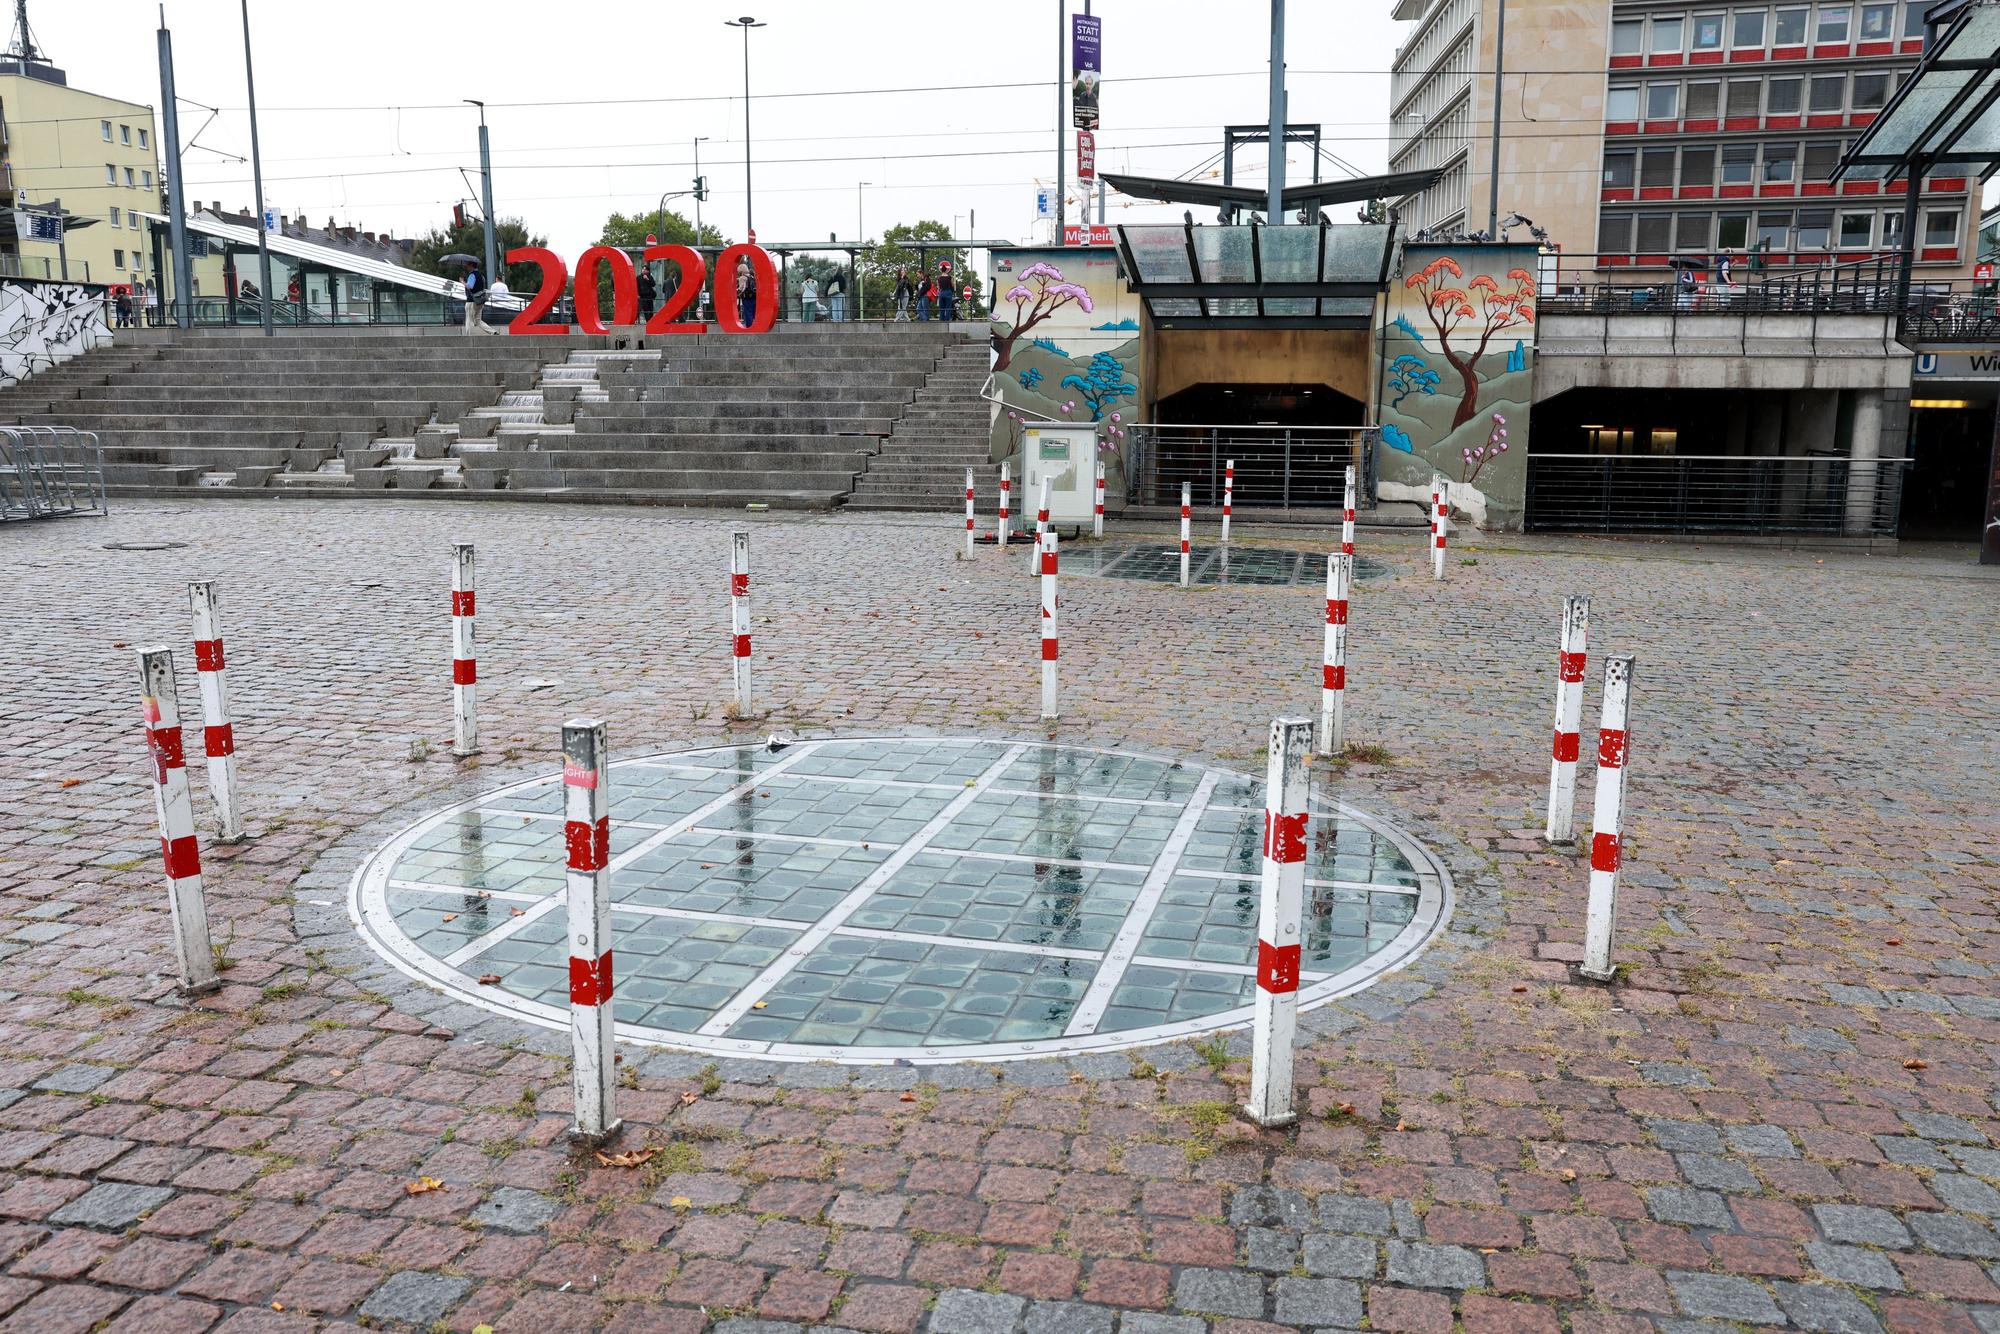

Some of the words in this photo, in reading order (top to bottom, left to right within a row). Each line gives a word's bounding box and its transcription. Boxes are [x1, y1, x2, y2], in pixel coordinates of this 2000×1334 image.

[1077, 25, 1099, 37] STATT
[1077, 34, 1099, 44] MECKERN
[19, 191, 26, 200] 4
[506, 243, 779, 335] 2020
[1917, 354, 1937, 373] U
[1970, 355, 2000, 371] Wi
